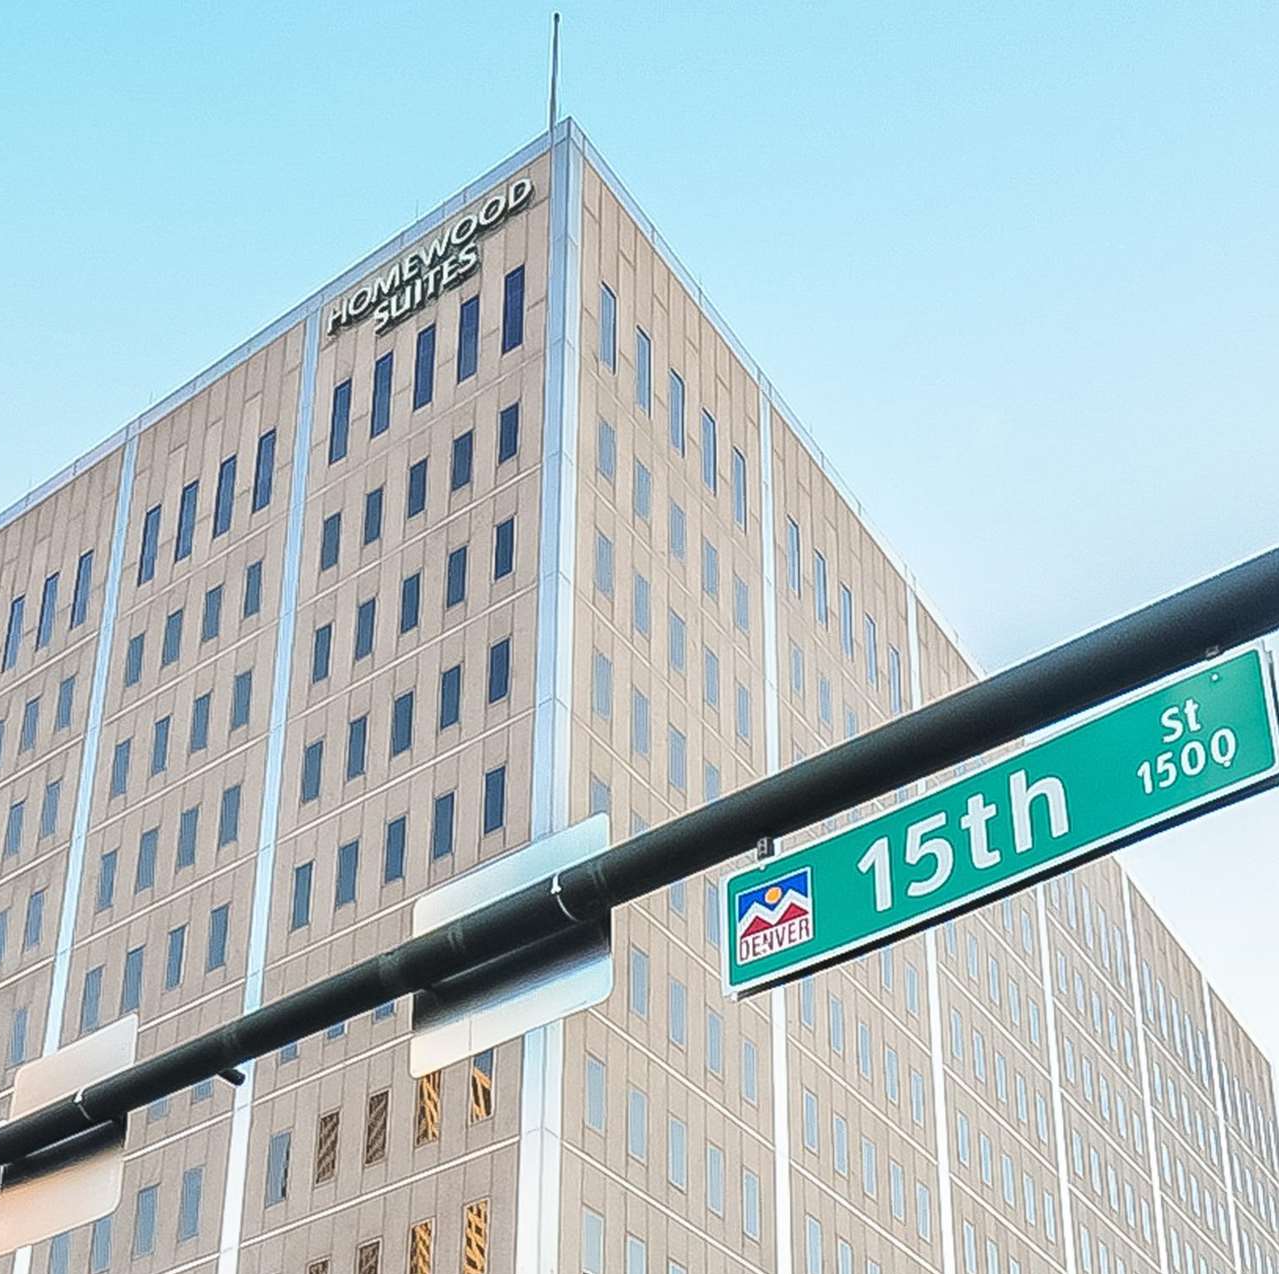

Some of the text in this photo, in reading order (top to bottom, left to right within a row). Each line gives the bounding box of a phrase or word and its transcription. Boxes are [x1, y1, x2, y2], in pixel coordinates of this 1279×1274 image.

[328, 177, 533, 334] HOMEWOOD
[375, 244, 478, 332] SUITES
[1160, 697, 1201, 744] St
[1137, 727, 1237, 796] 1500
[857, 769, 1070, 912] 15th
[740, 917, 810, 961] DENVER
